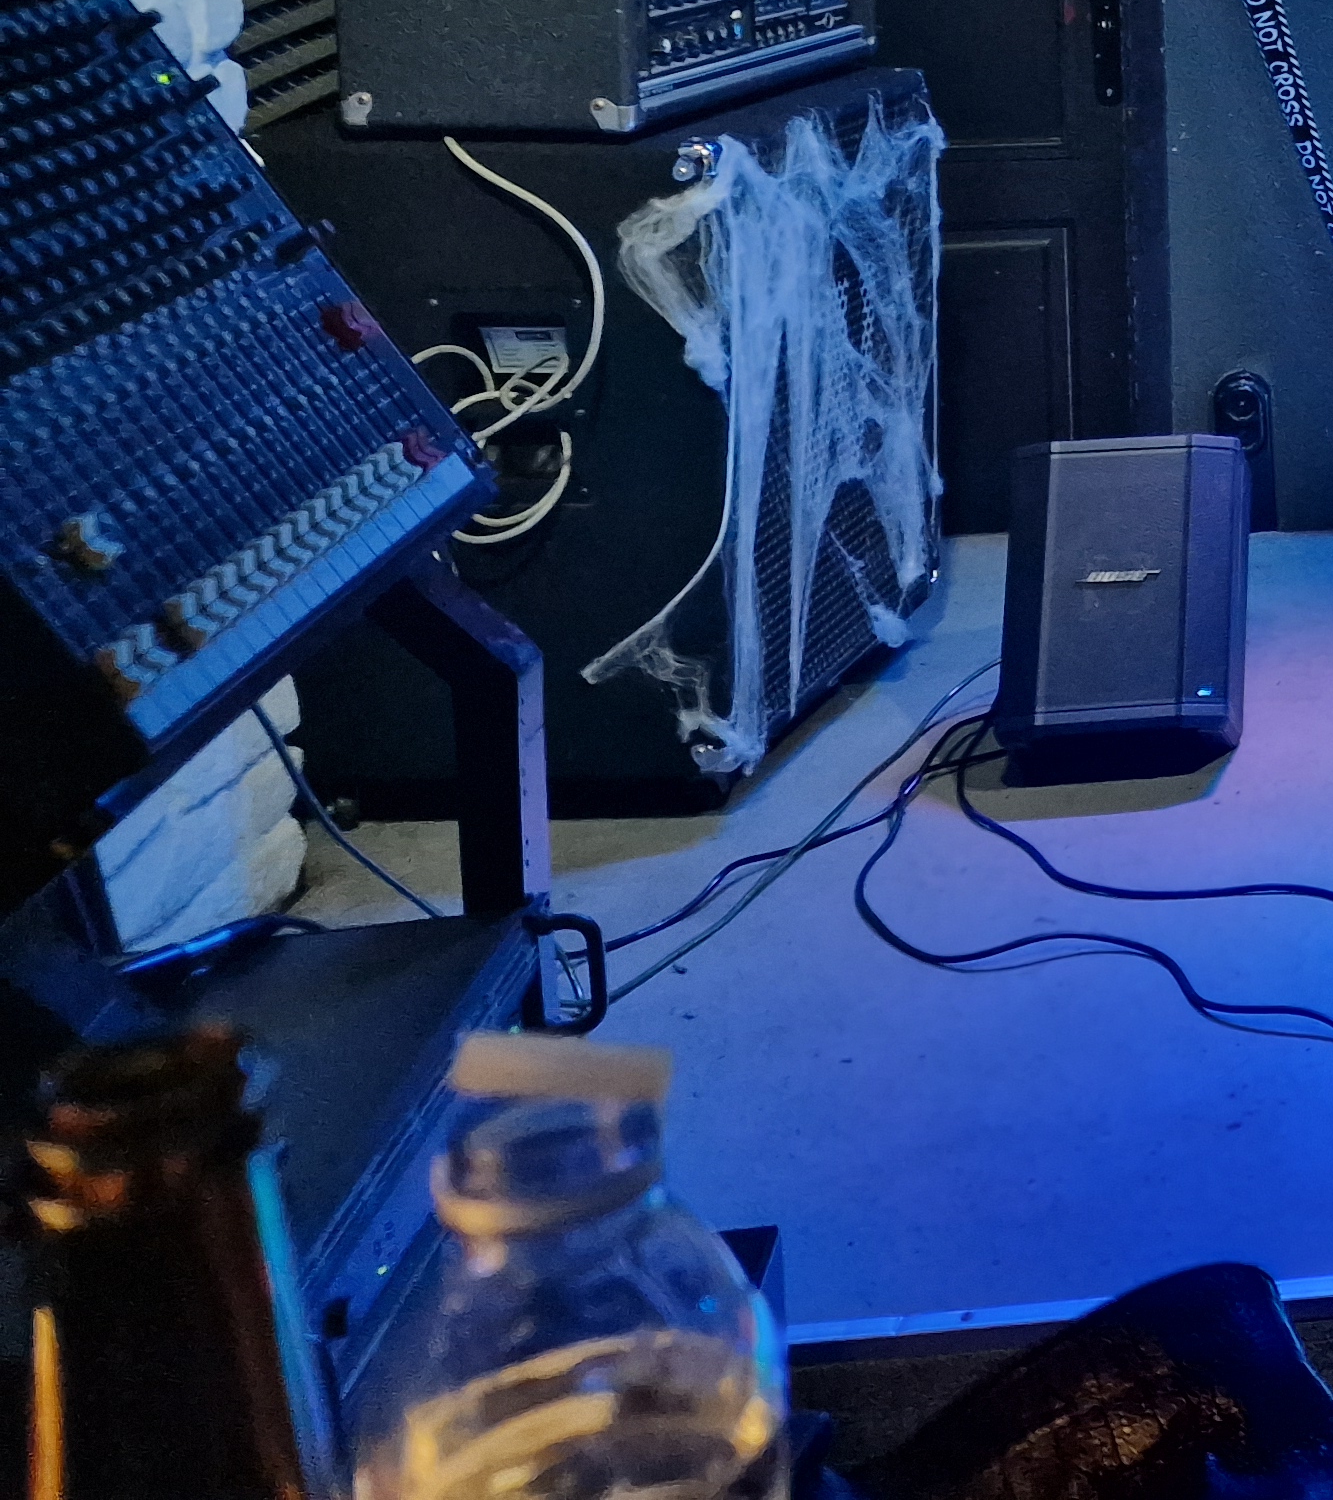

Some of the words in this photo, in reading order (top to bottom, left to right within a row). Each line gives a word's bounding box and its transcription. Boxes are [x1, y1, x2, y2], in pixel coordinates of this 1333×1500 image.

[1253, 10, 1284, 53] NOT
[1269, 61, 1303, 127] CROSS
[1295, 140, 1315, 169] DO
[1308, 174, 1333, 216] NOT
